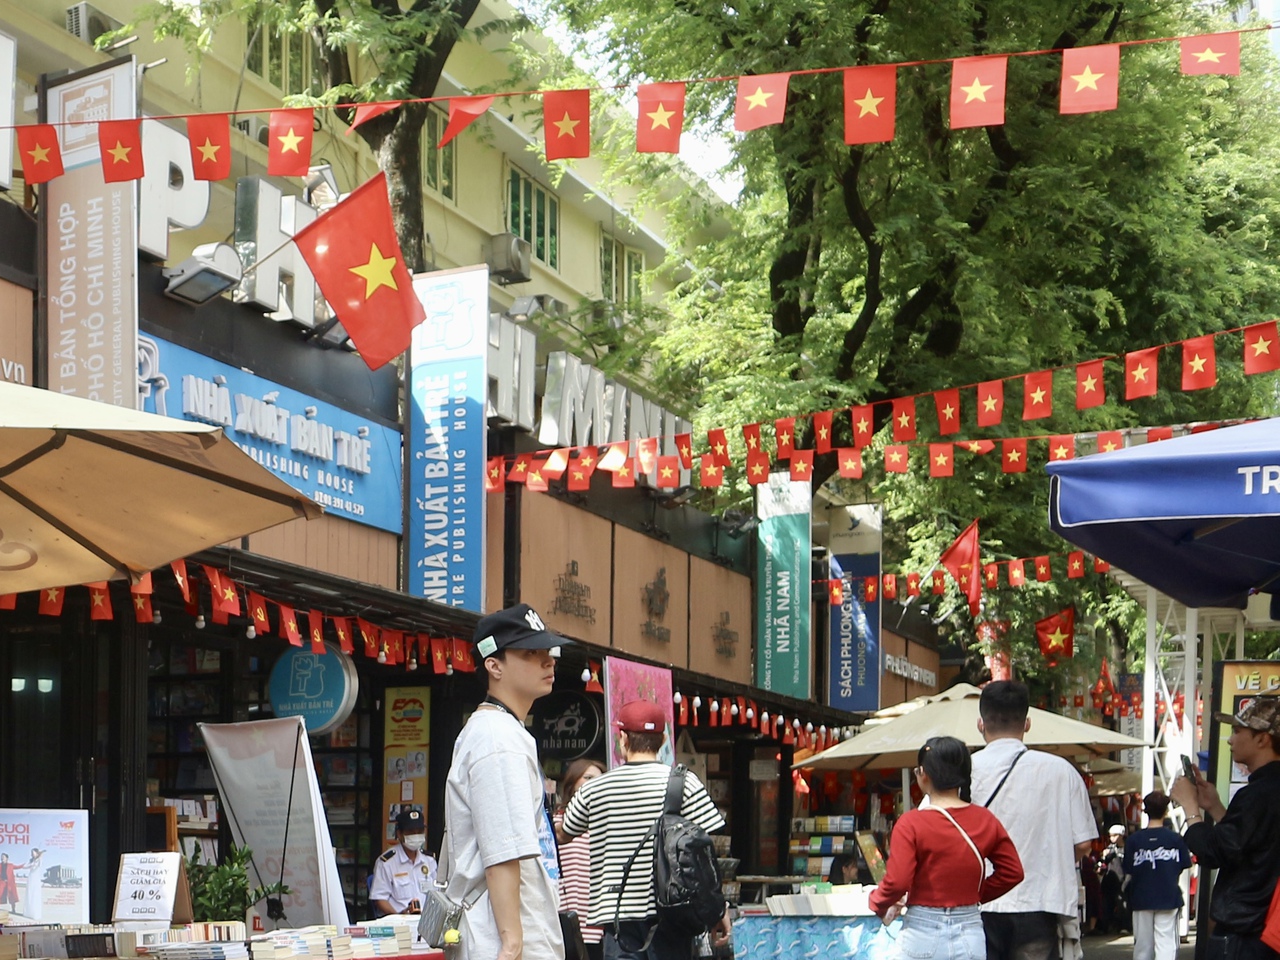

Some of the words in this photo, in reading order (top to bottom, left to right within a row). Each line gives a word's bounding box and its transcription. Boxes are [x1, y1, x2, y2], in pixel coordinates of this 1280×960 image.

[60, 202, 79, 250] HỢP
[87, 196, 104, 259] MINH
[111, 190, 121, 233] HOUSE
[51, 256, 77, 323] TỔNG
[83, 263, 104, 307] CHÍ
[112, 240, 122, 315] PUBLISHING
[54, 329, 77, 378] BẢN
[81, 312, 105, 349] HỒ
[113, 317, 122, 376] GENERAL
[417, 374, 449, 425] TRẺ
[454, 371, 467, 430] HOUSE
[182, 374, 233, 427] NHÀ
[234, 391, 290, 445] XUẤT
[291, 405, 333, 461] BẢN
[334, 426, 371, 475] TRẺ
[416, 426, 449, 479] BẢN
[317, 469, 354, 495] HOUSE
[453, 449, 466, 562] PUBLISHING
[416, 484, 449, 548] XUẤT
[418, 551, 449, 605] NHÀ
[452, 574, 465, 606] TRE
[776, 571, 790, 610] NAM
[841, 571, 852, 600] NAM
[773, 615, 790, 652] NHÃ
[840, 603, 852, 657] PHƯƠNG
[857, 613, 866, 638] NAM
[839, 660, 852, 697] SÁCH
[857, 641, 866, 686] PHUONG
[565, 738, 587, 748] nam
[131, 889, 145, 900] 40
[148, 889, 161, 900] %
